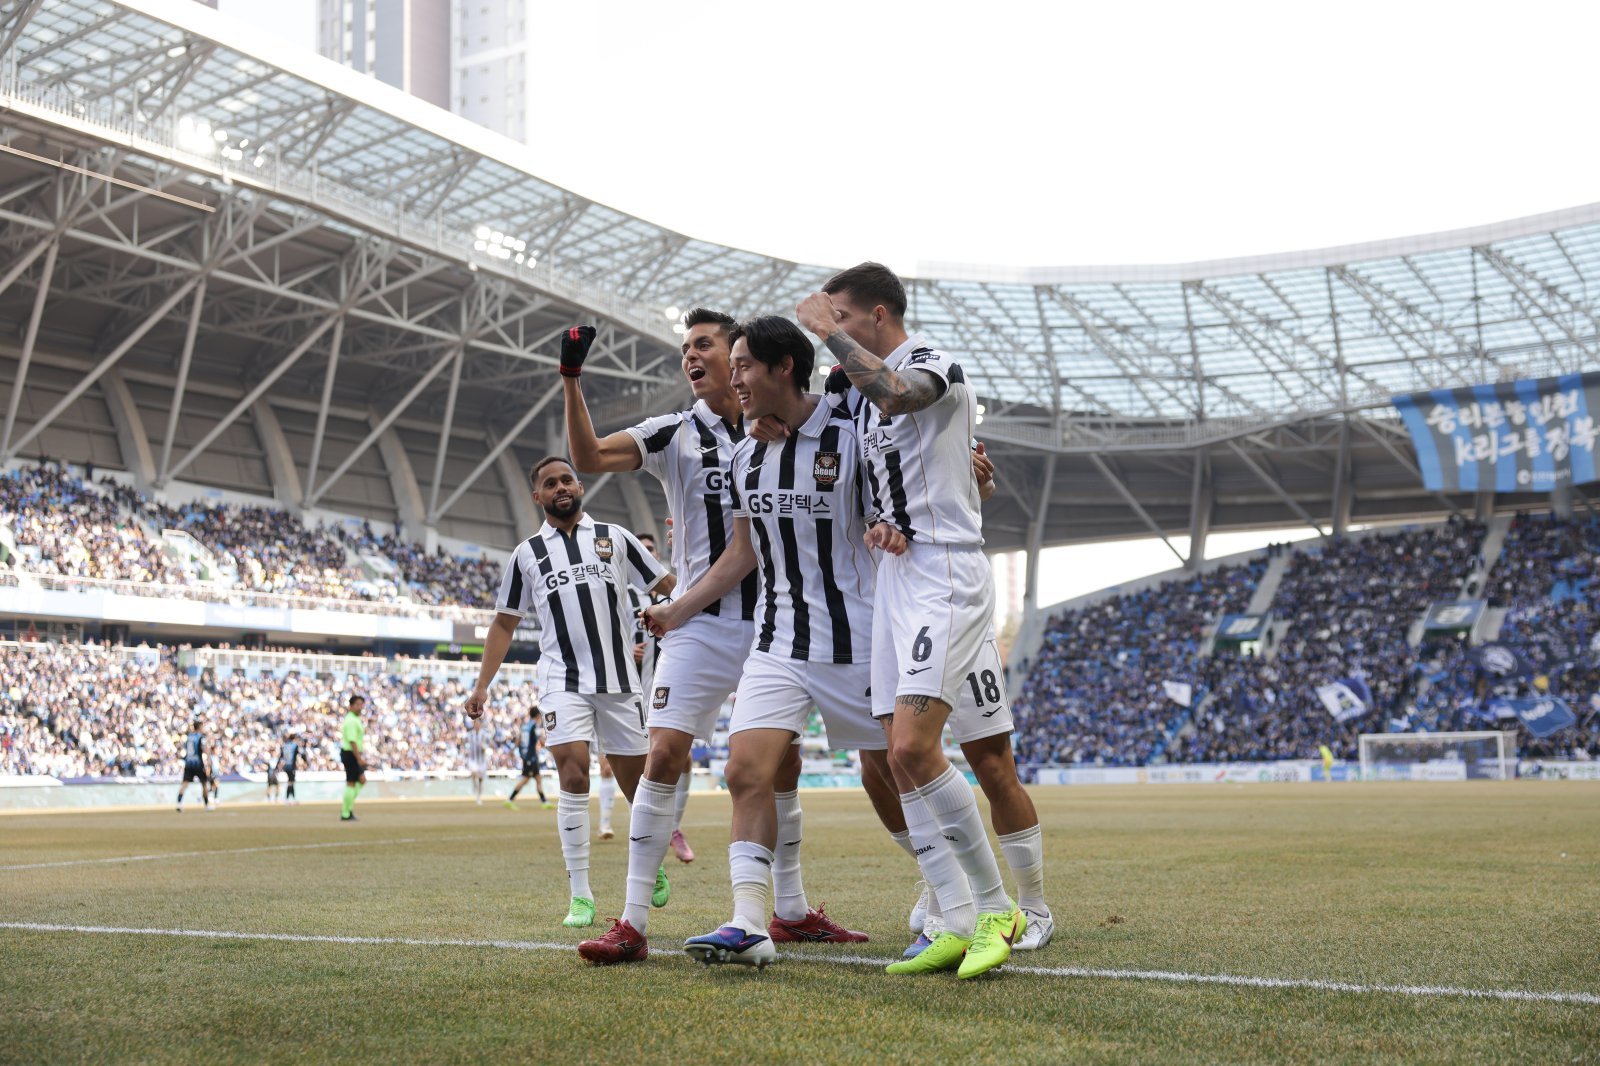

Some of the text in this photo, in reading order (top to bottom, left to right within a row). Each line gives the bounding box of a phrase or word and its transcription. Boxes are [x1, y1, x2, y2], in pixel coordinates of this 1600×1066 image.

[747, 492, 831, 515] GS 칼텍스
[545, 563, 613, 590] GS 칼텍스
[911, 625, 933, 662] 6
[966, 669, 1001, 708] 18
[634, 701, 647, 730] 1
